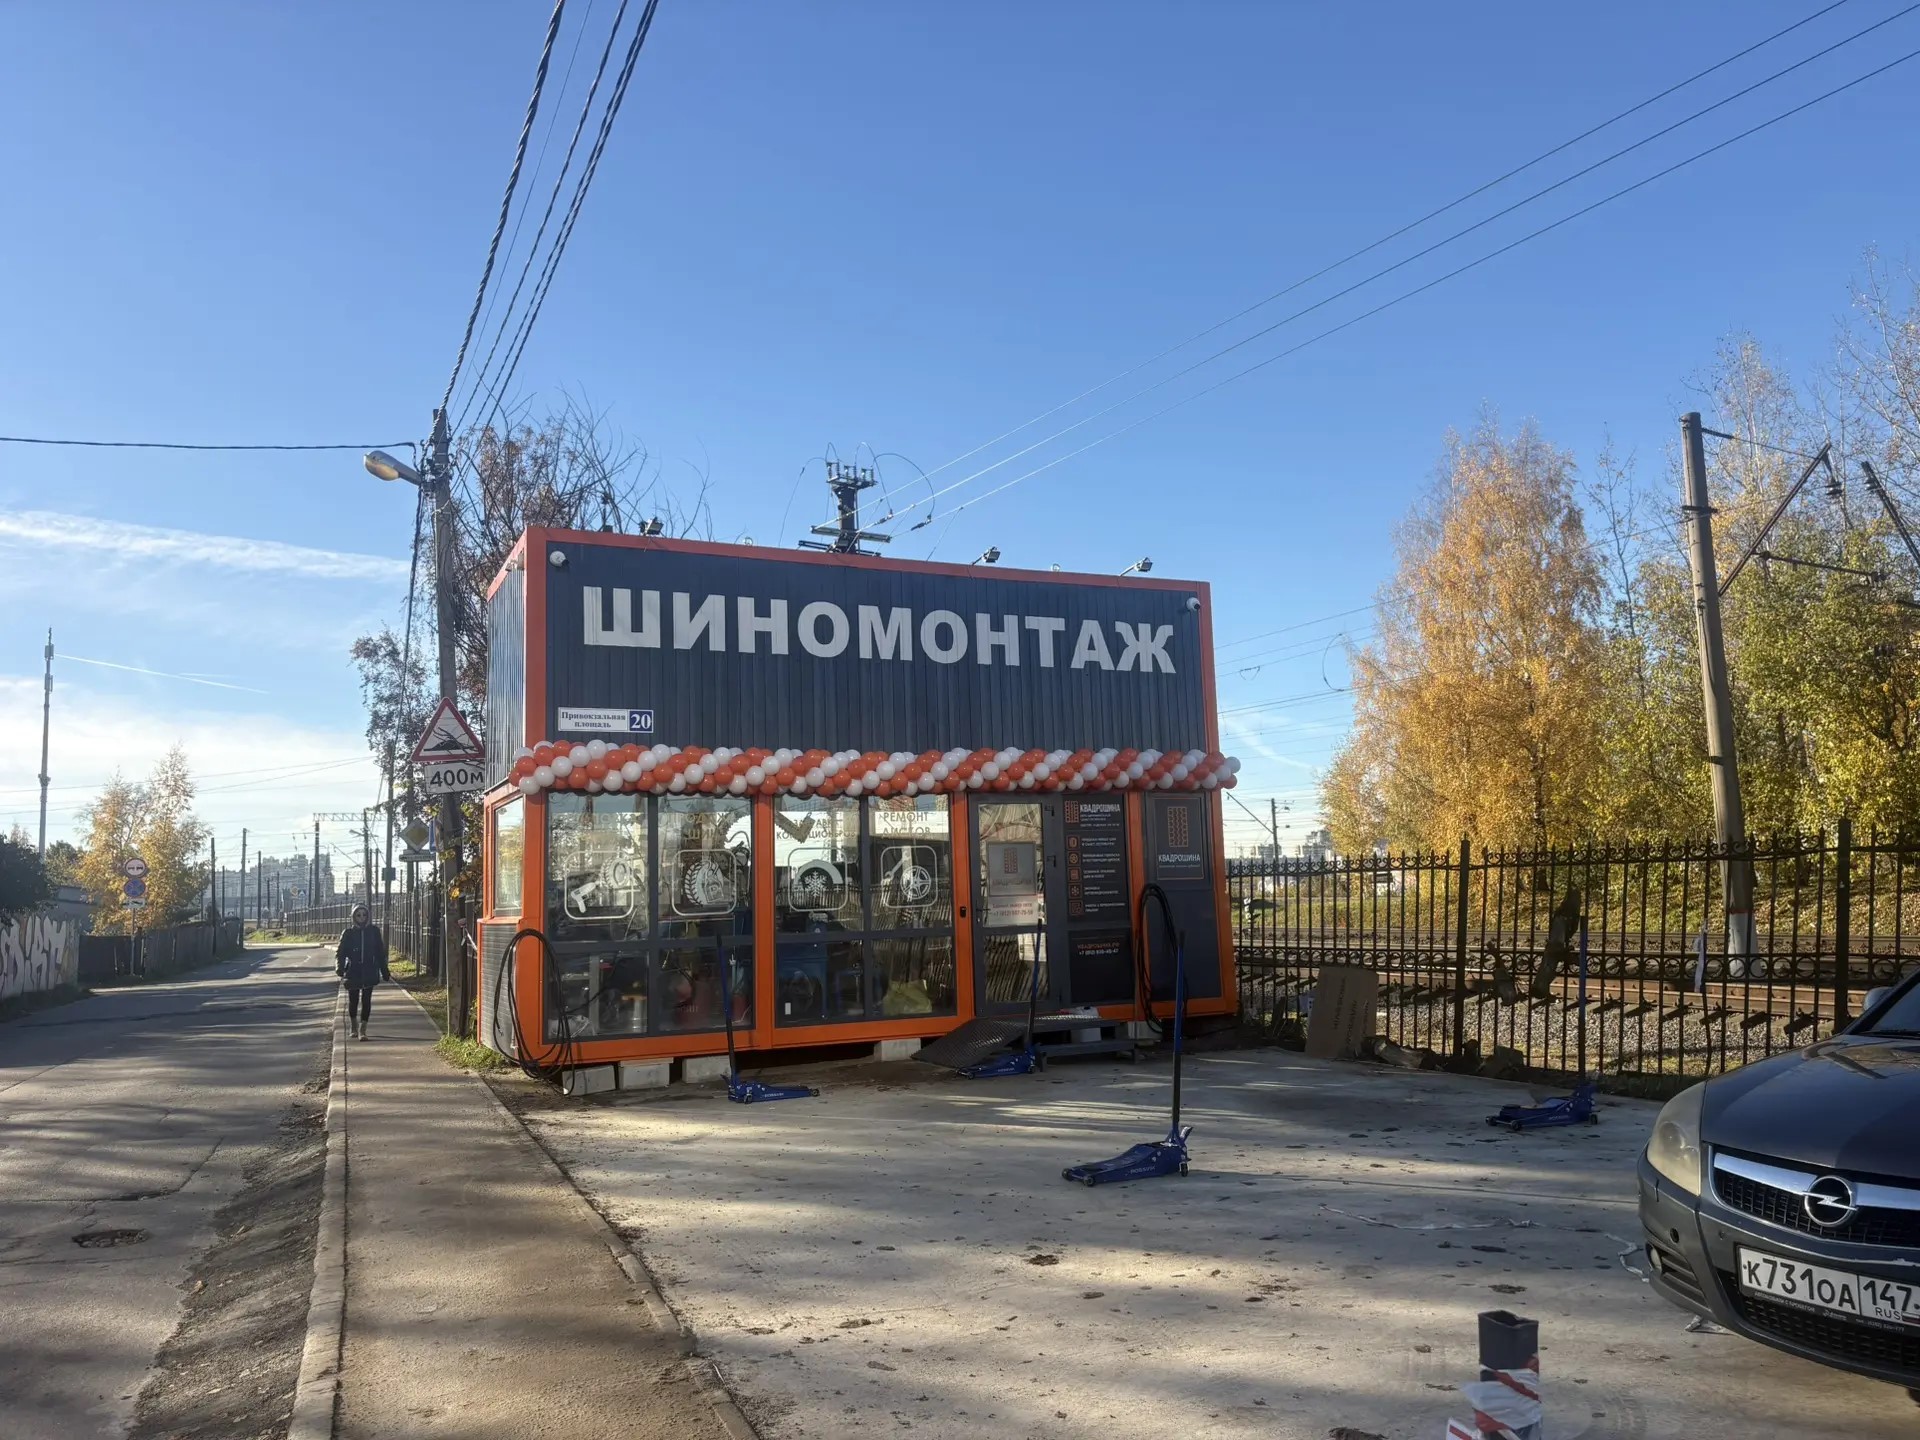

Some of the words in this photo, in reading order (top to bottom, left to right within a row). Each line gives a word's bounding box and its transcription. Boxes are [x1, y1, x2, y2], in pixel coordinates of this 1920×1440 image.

[583, 586, 1177, 674] ШИНОМОНТАЖ
[561, 711, 626, 721] Привокзальная
[630, 713, 652, 730] 20
[574, 721, 612, 729] площадь
[883, 812, 929, 823] РЕМОНТ
[1158, 853, 1201, 864] КВАДРОШИНА
[1747, 1257, 1857, 1311] К731ОА
[1862, 1279, 1913, 1312] 147
[1874, 1306, 1901, 1320] RUS
